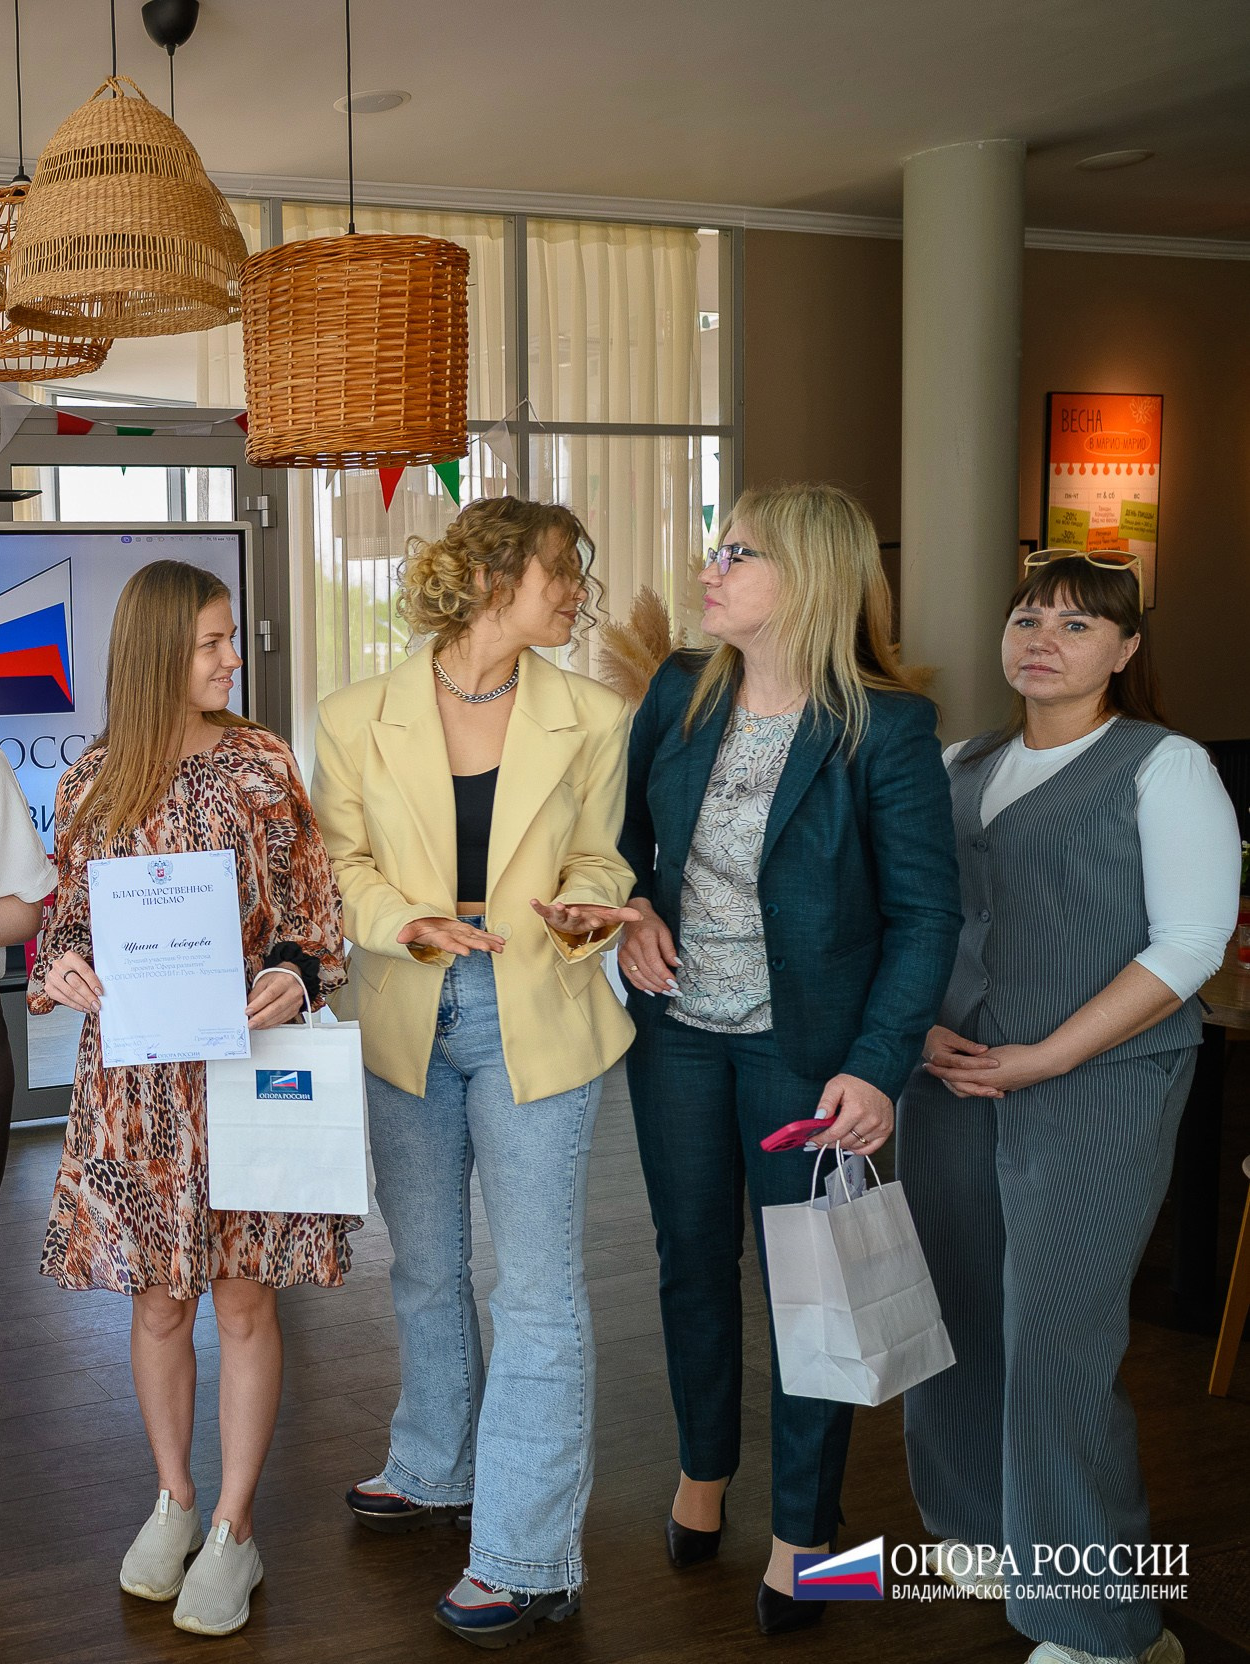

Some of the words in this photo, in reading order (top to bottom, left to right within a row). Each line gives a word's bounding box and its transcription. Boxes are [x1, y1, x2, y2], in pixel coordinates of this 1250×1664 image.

[1061, 408, 1103, 433] ВЕСНА
[112, 884, 214, 899] БЛАГОДАРСТВЕННОЕ
[142, 896, 185, 906] ПИСЬМО
[121, 941, 159, 954] Ирина
[165, 937, 212, 950] Лебедева
